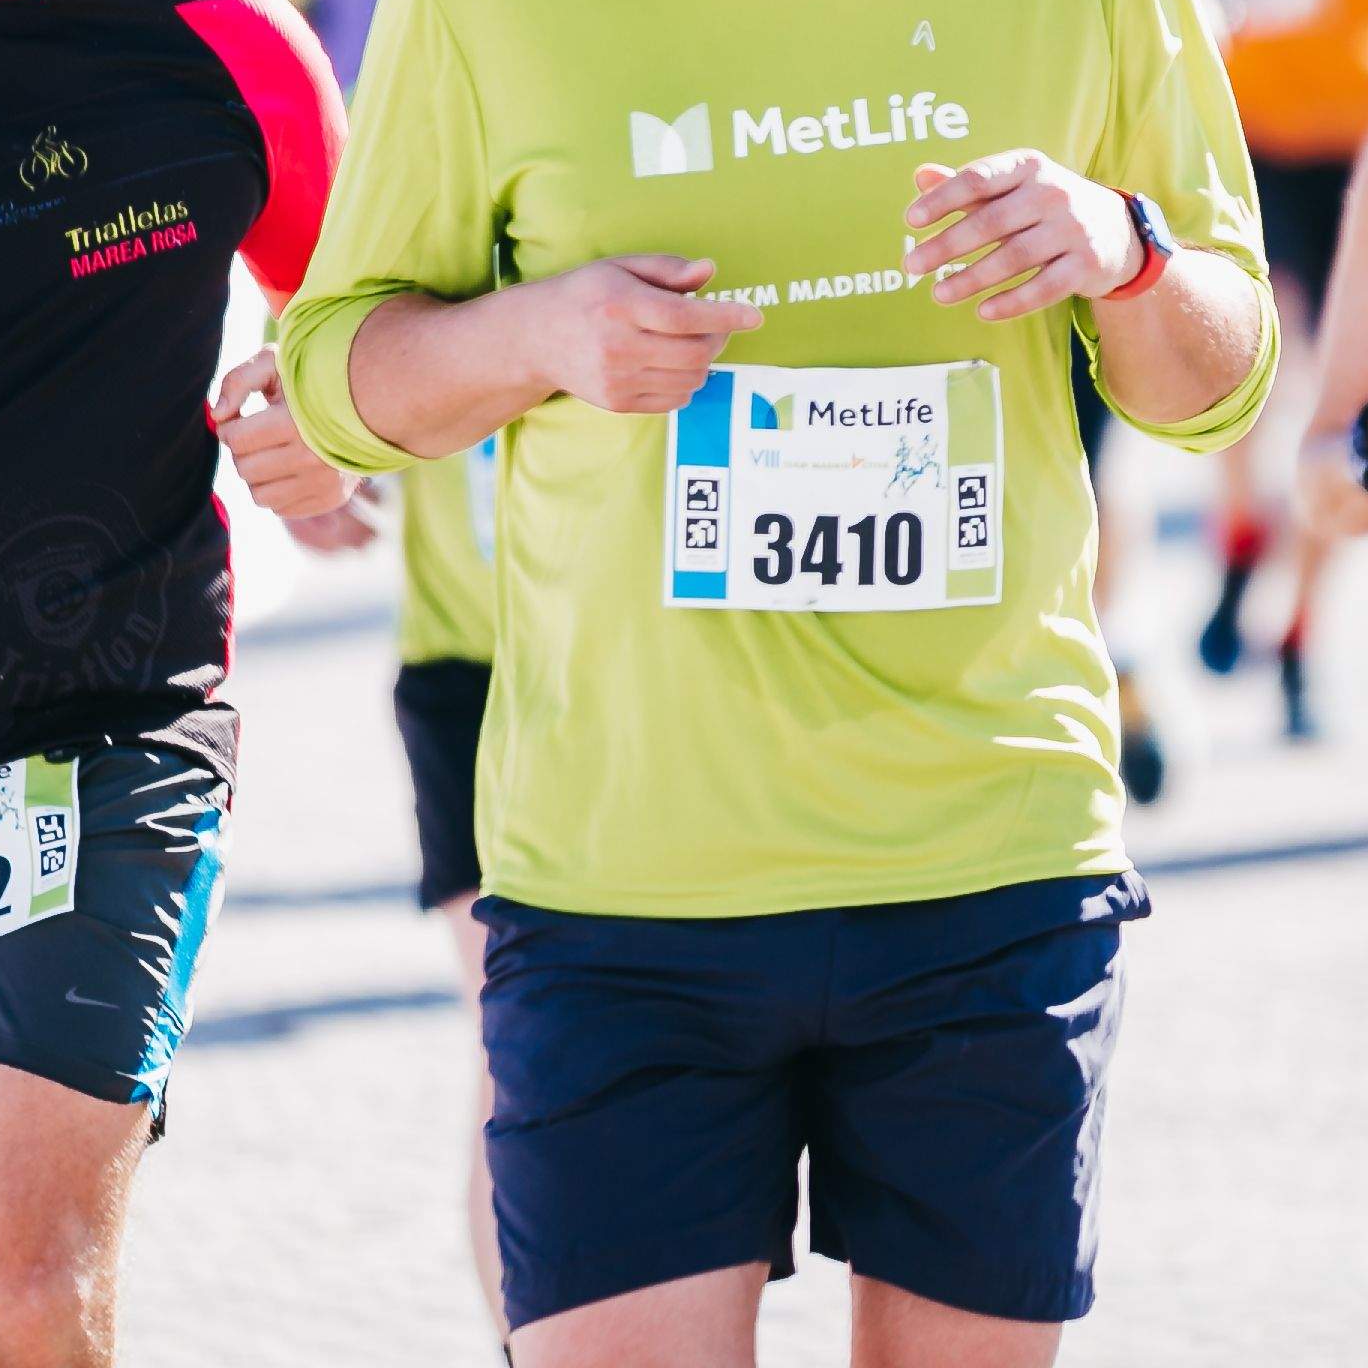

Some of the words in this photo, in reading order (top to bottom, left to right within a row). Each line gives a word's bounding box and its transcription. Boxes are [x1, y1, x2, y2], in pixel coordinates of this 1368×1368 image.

[733, 92, 970, 158] MetLife
[70, 237, 147, 279] MAREA
[151, 221, 198, 252] ROSA
[704, 284, 780, 308] KM
[808, 398, 934, 427] MetLife
[752, 511, 923, 586] 3410
